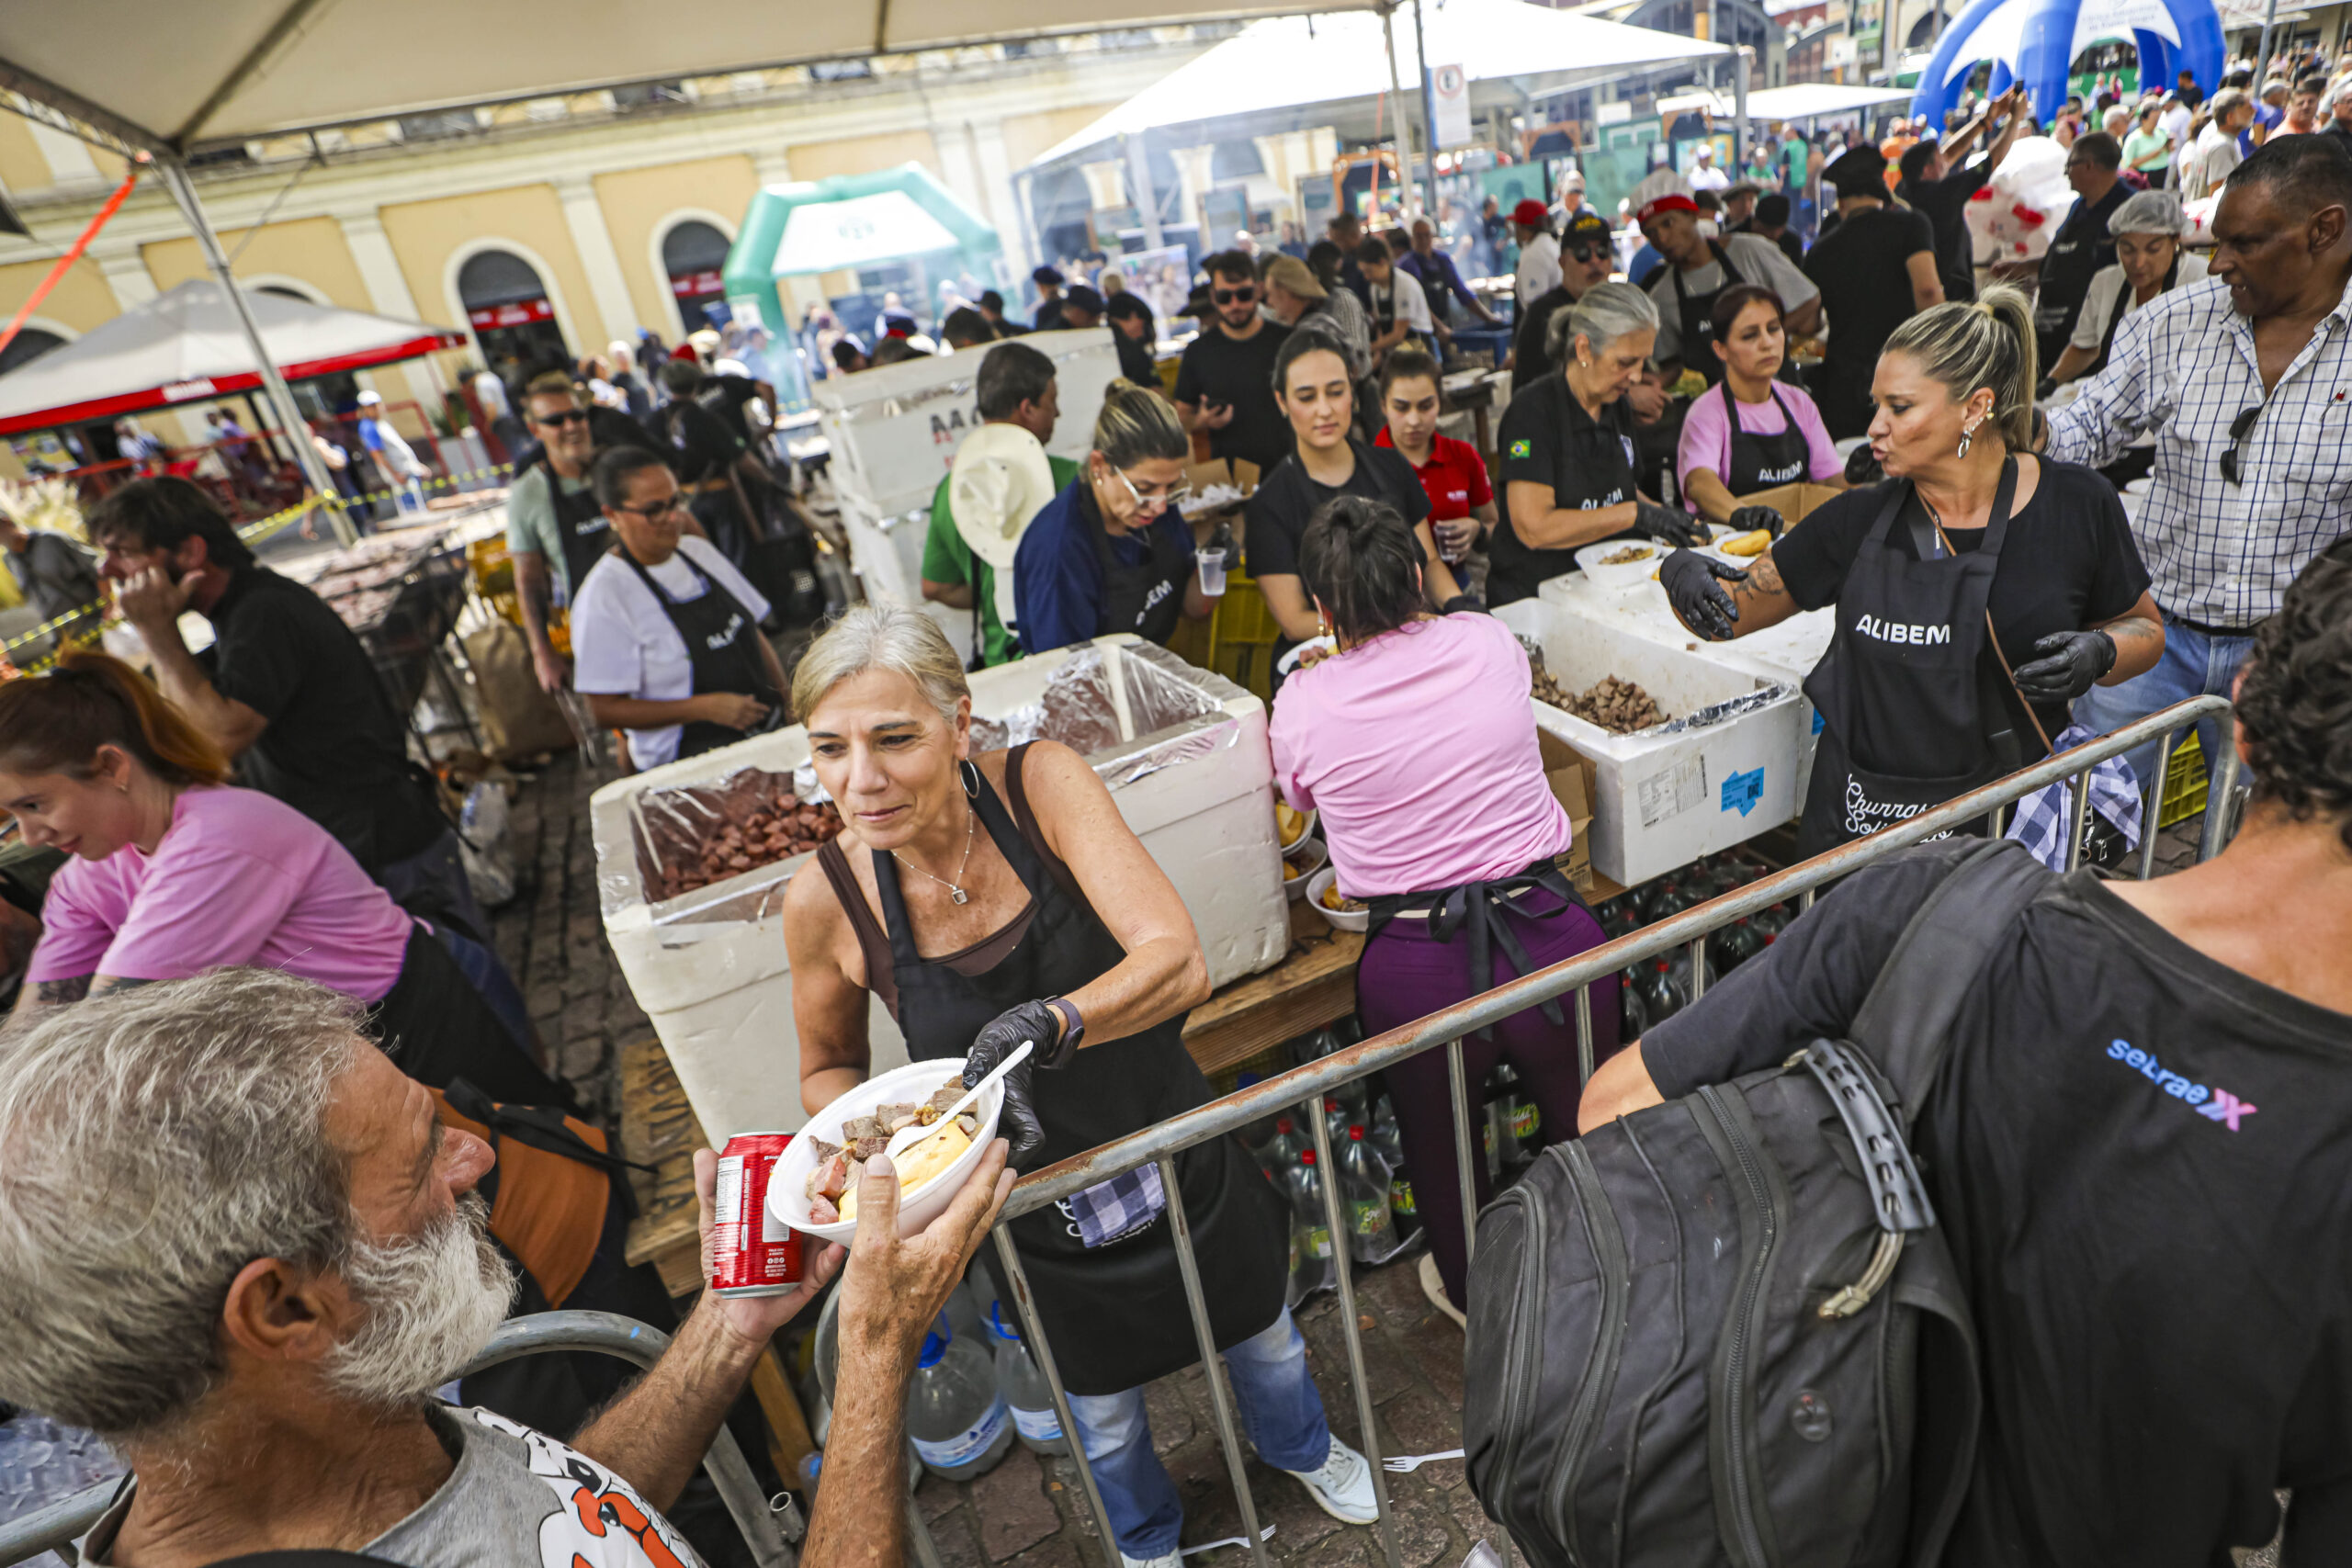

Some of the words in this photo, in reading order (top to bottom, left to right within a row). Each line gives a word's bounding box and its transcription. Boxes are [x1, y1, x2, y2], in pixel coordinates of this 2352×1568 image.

[1580, 488, 1623, 511] ALM
[1855, 614, 1951, 645] ALIBEM
[1846, 773, 1937, 819] Churras
